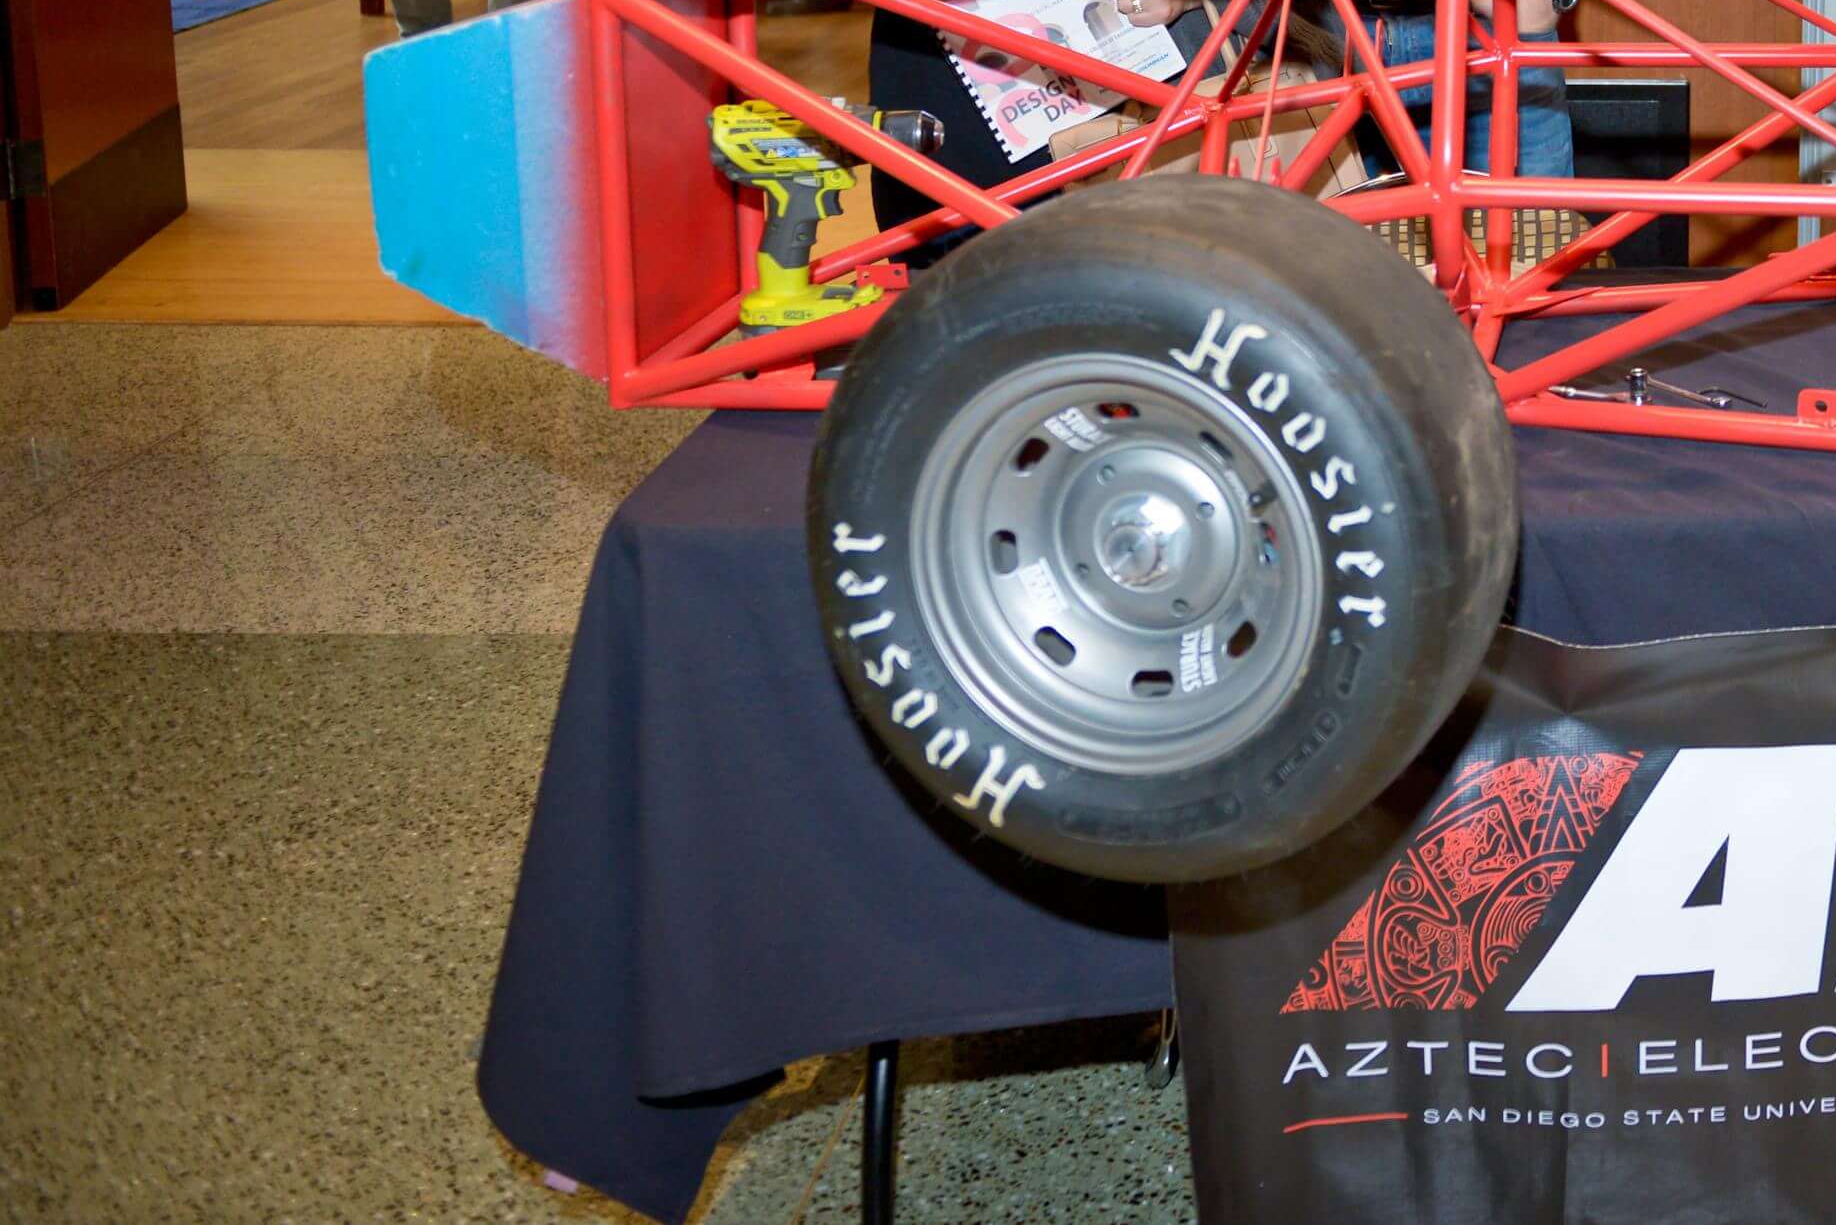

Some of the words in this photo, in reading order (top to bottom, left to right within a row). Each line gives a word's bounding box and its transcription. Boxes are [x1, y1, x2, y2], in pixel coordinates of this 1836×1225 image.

[1001, 75, 1077, 123] DESIGN
[1043, 82, 1088, 123] DAY
[1169, 308, 1395, 629] Hoosier
[832, 521, 1047, 828] Hoosier
[1282, 1040, 1574, 1085] AZTEC
[1423, 1107, 1487, 1124] SAN
[1502, 1109, 1606, 1129] DIEGO
[1623, 1106, 1728, 1126] STATE
